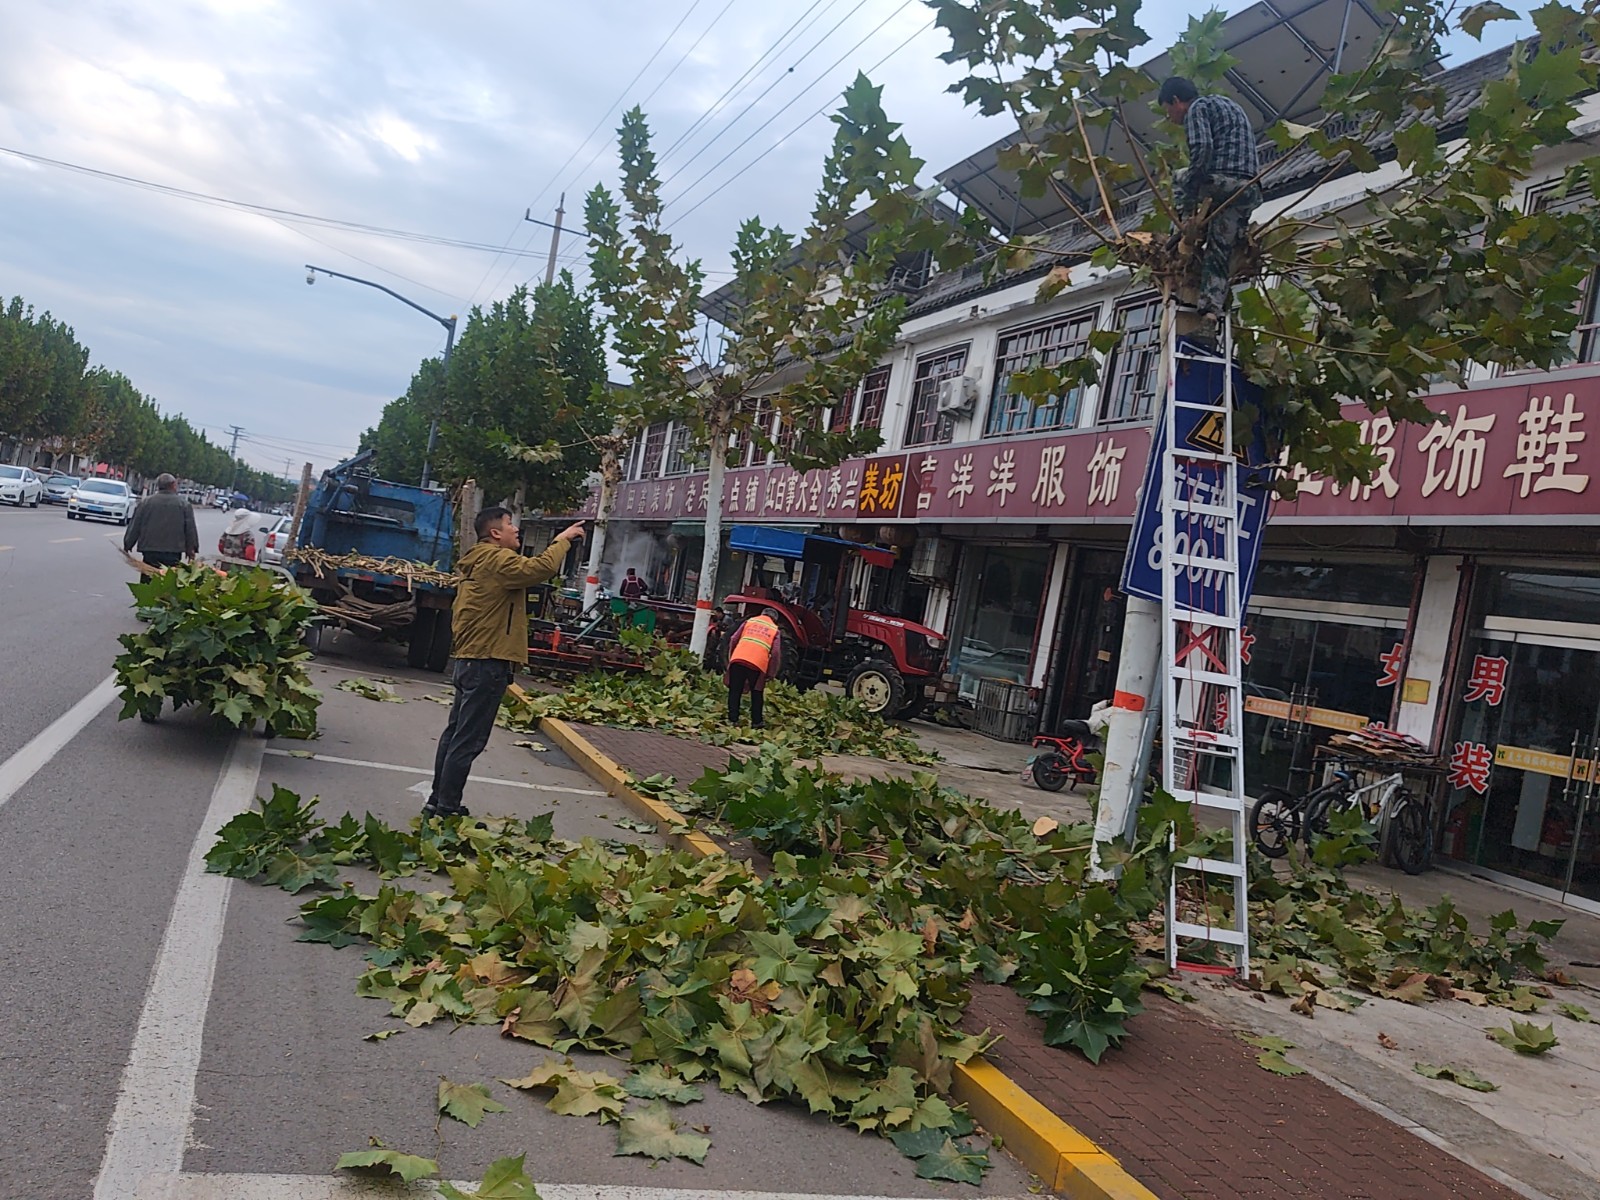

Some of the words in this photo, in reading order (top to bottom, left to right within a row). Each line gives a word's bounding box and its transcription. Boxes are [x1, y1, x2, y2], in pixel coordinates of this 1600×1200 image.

[685, 475, 760, 512] 老兵点铺
[764, 469, 822, 512] 红白事大全
[826, 462, 903, 513] 秀兰美坊
[1447, 655, 1509, 795] 男装
